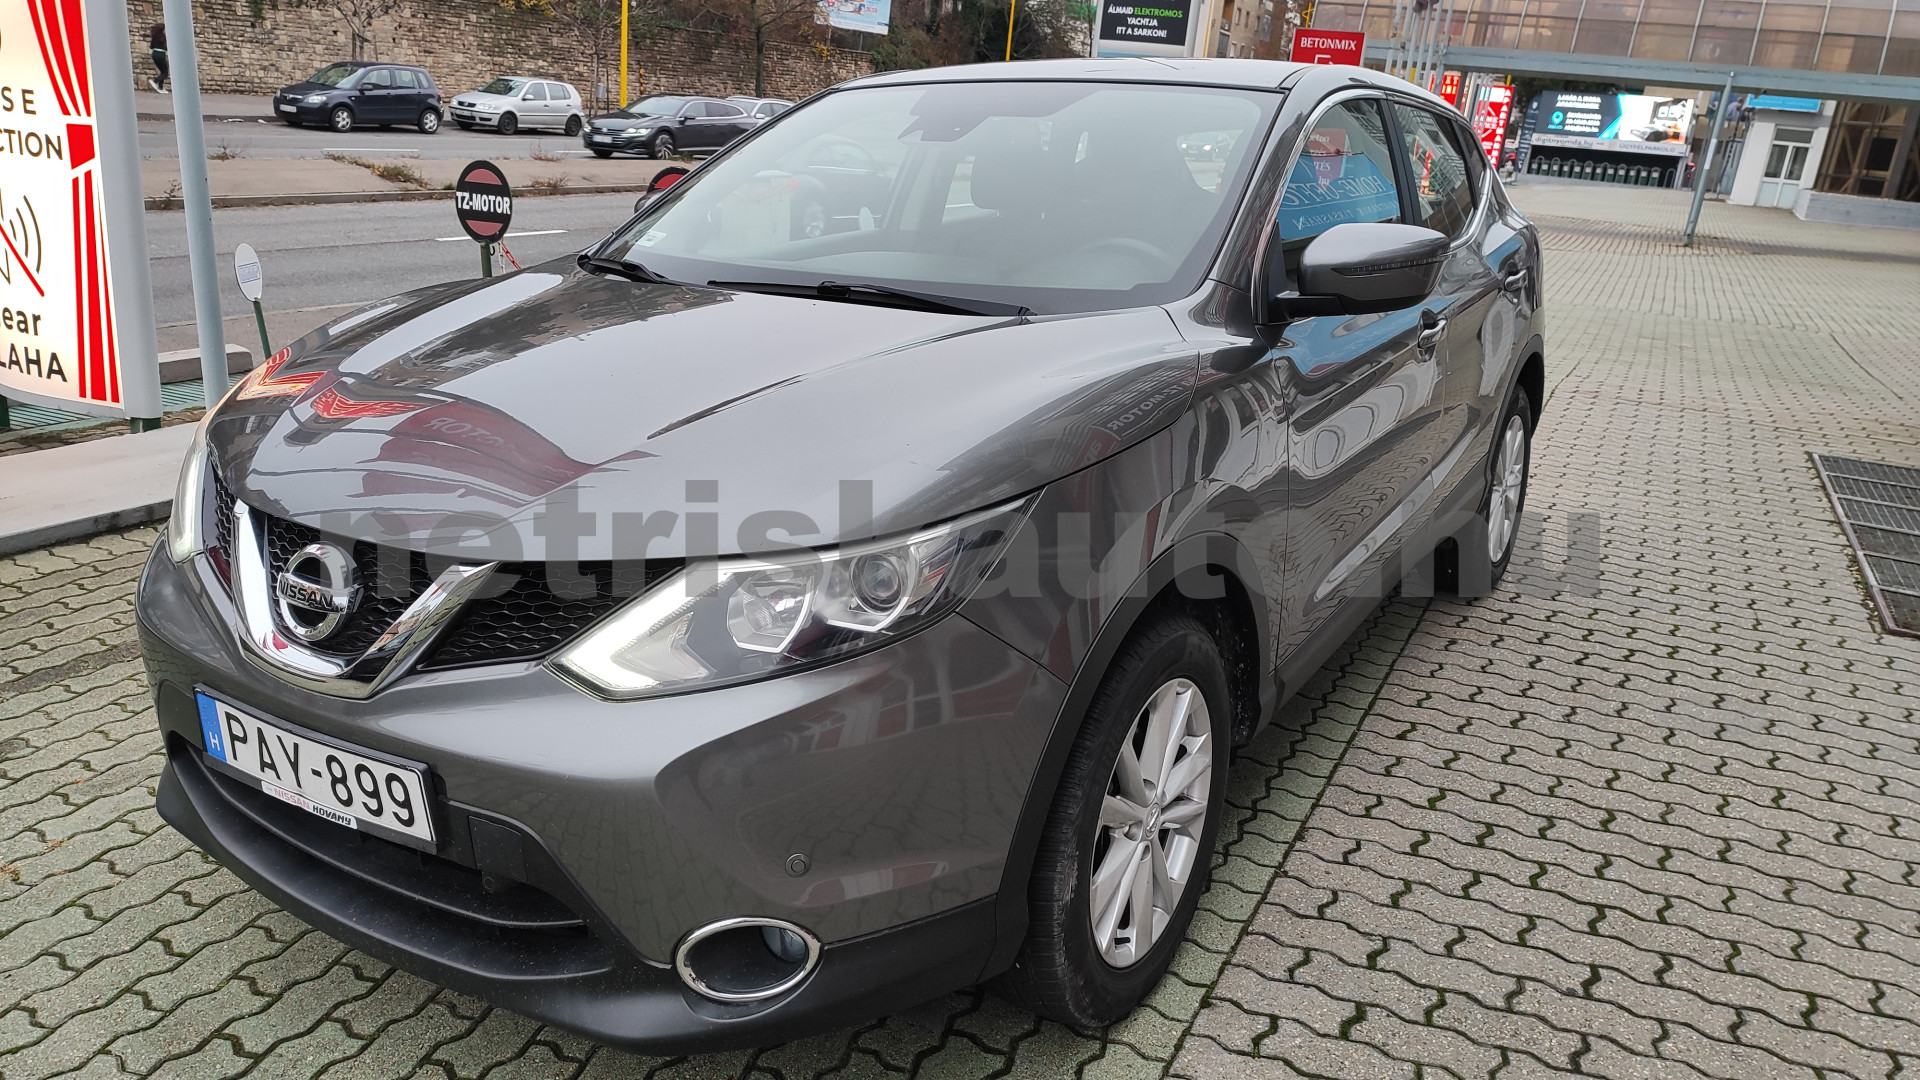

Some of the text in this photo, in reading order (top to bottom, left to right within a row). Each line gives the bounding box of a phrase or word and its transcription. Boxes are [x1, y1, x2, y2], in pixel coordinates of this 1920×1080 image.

[1107, 4, 1183, 18] ÁLMAID ELEKTROMOS
[1127, 16, 1158, 27] YACHTJA
[1116, 27, 1167, 38] ITT A SARKON!
[1300, 36, 1357, 51] BETONMIX
[1, 86, 37, 116] SE
[456, 191, 511, 215] TZ-MOTOR
[0, 306, 41, 336] ear
[280, 577, 334, 608] NISSAN
[209, 711, 415, 828] H PAY-899
[273, 788, 311, 811] NISSAN
